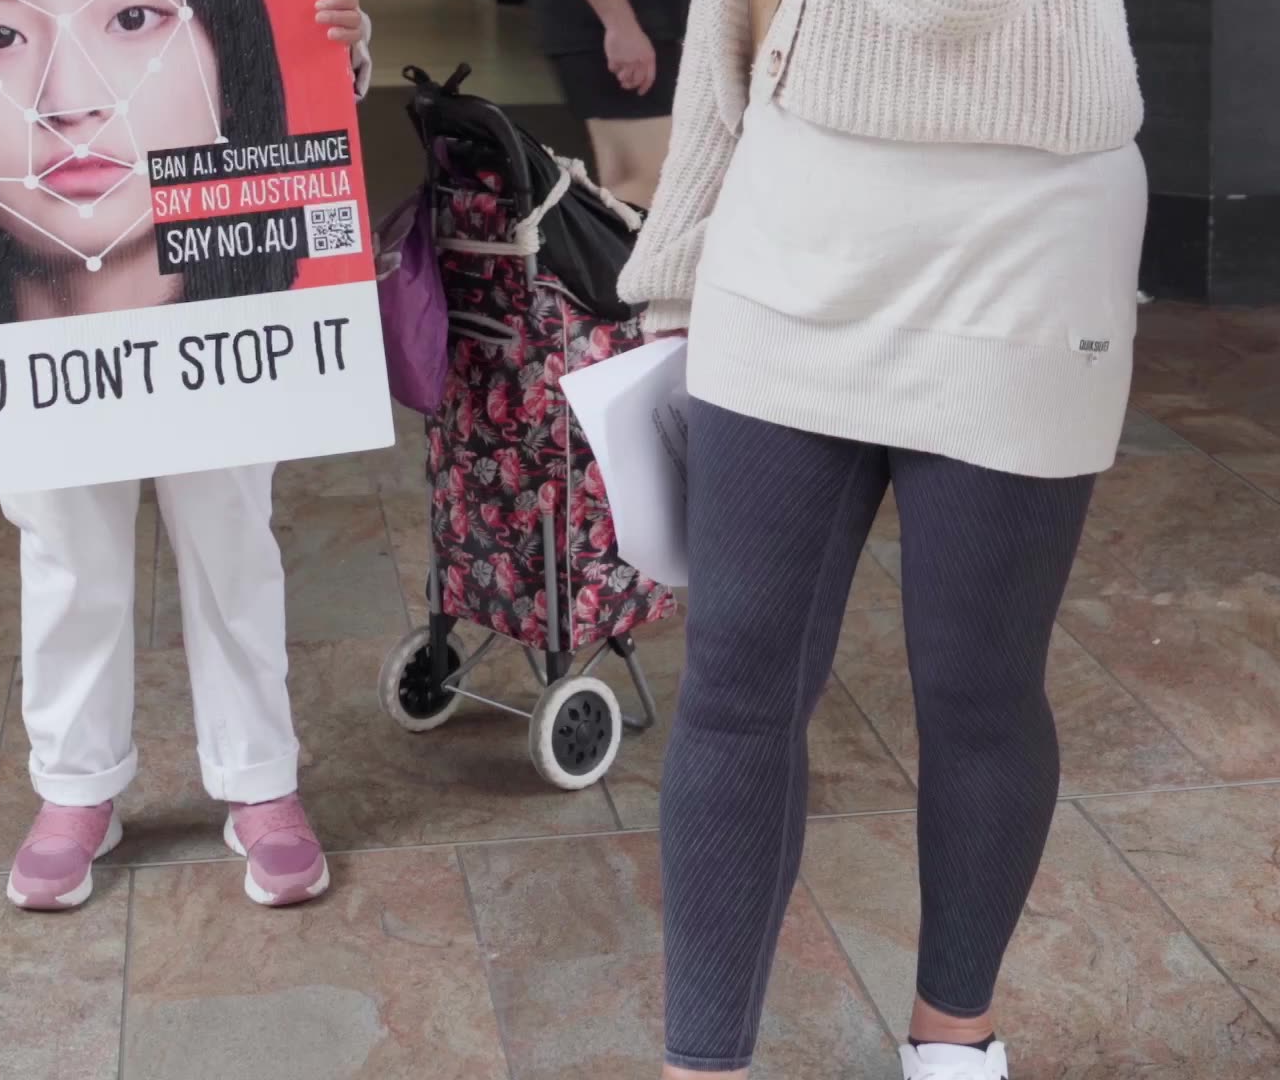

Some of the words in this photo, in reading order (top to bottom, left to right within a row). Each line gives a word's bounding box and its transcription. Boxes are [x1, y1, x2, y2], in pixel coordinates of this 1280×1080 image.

[151, 156, 186, 180] BAN
[193, 151, 217, 175] A.I.
[222, 136, 349, 172] SURVEILLANCE
[155, 188, 192, 216] SAY
[201, 184, 231, 211] NO
[240, 169, 351, 207] AUSTRALIA
[29, 340, 159, 409] DON'T
[179, 325, 294, 391] STOP
[314, 318, 350, 375] IT
